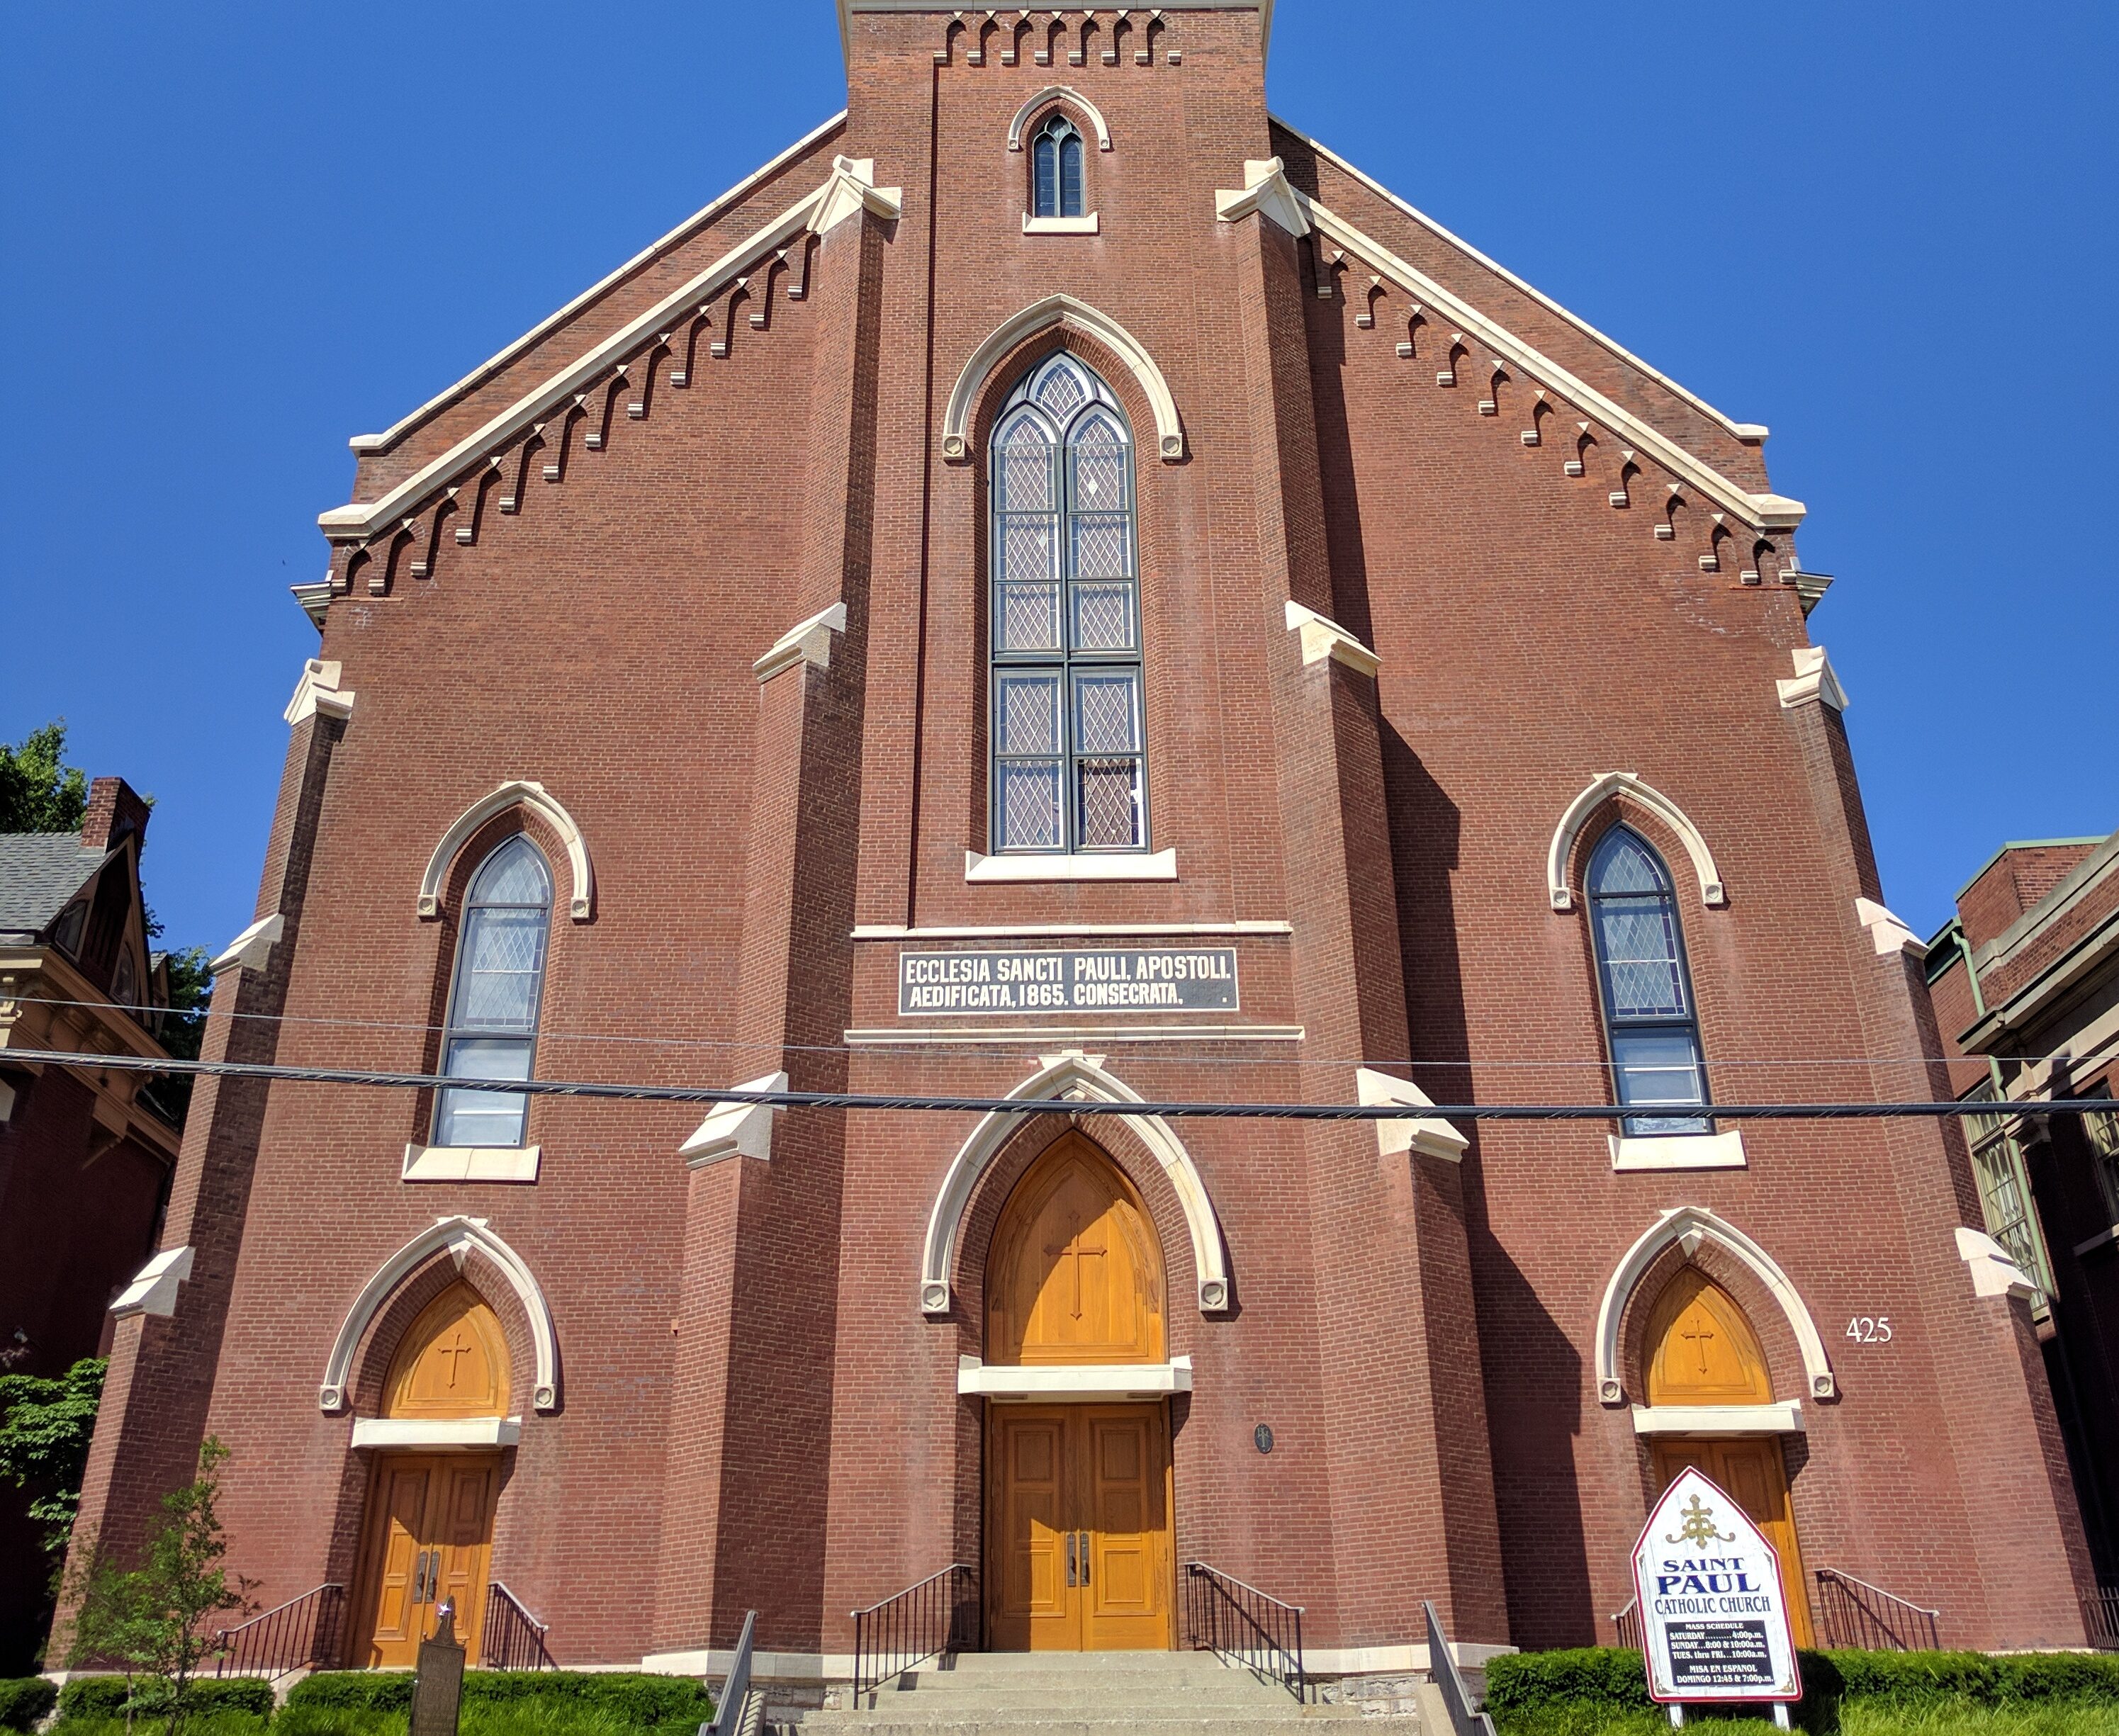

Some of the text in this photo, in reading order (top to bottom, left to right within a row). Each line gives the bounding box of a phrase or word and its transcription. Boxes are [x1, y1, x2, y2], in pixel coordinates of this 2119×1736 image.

[906, 959, 990, 983] ECCLESIA
[997, 957, 1062, 982] SANCTI
[1136, 955, 1231, 979] APOSTOLI.
[1020, 983, 1069, 1006] 1865.
[1074, 983, 1183, 1005] CONSECRATA,
[1846, 1317, 1892, 1342] 425
[1663, 1557, 1745, 1572] SAINT
[1656, 1573, 1761, 1595] PAUL
[1655, 1596, 1771, 1615] CATHOLIC CHURCH
